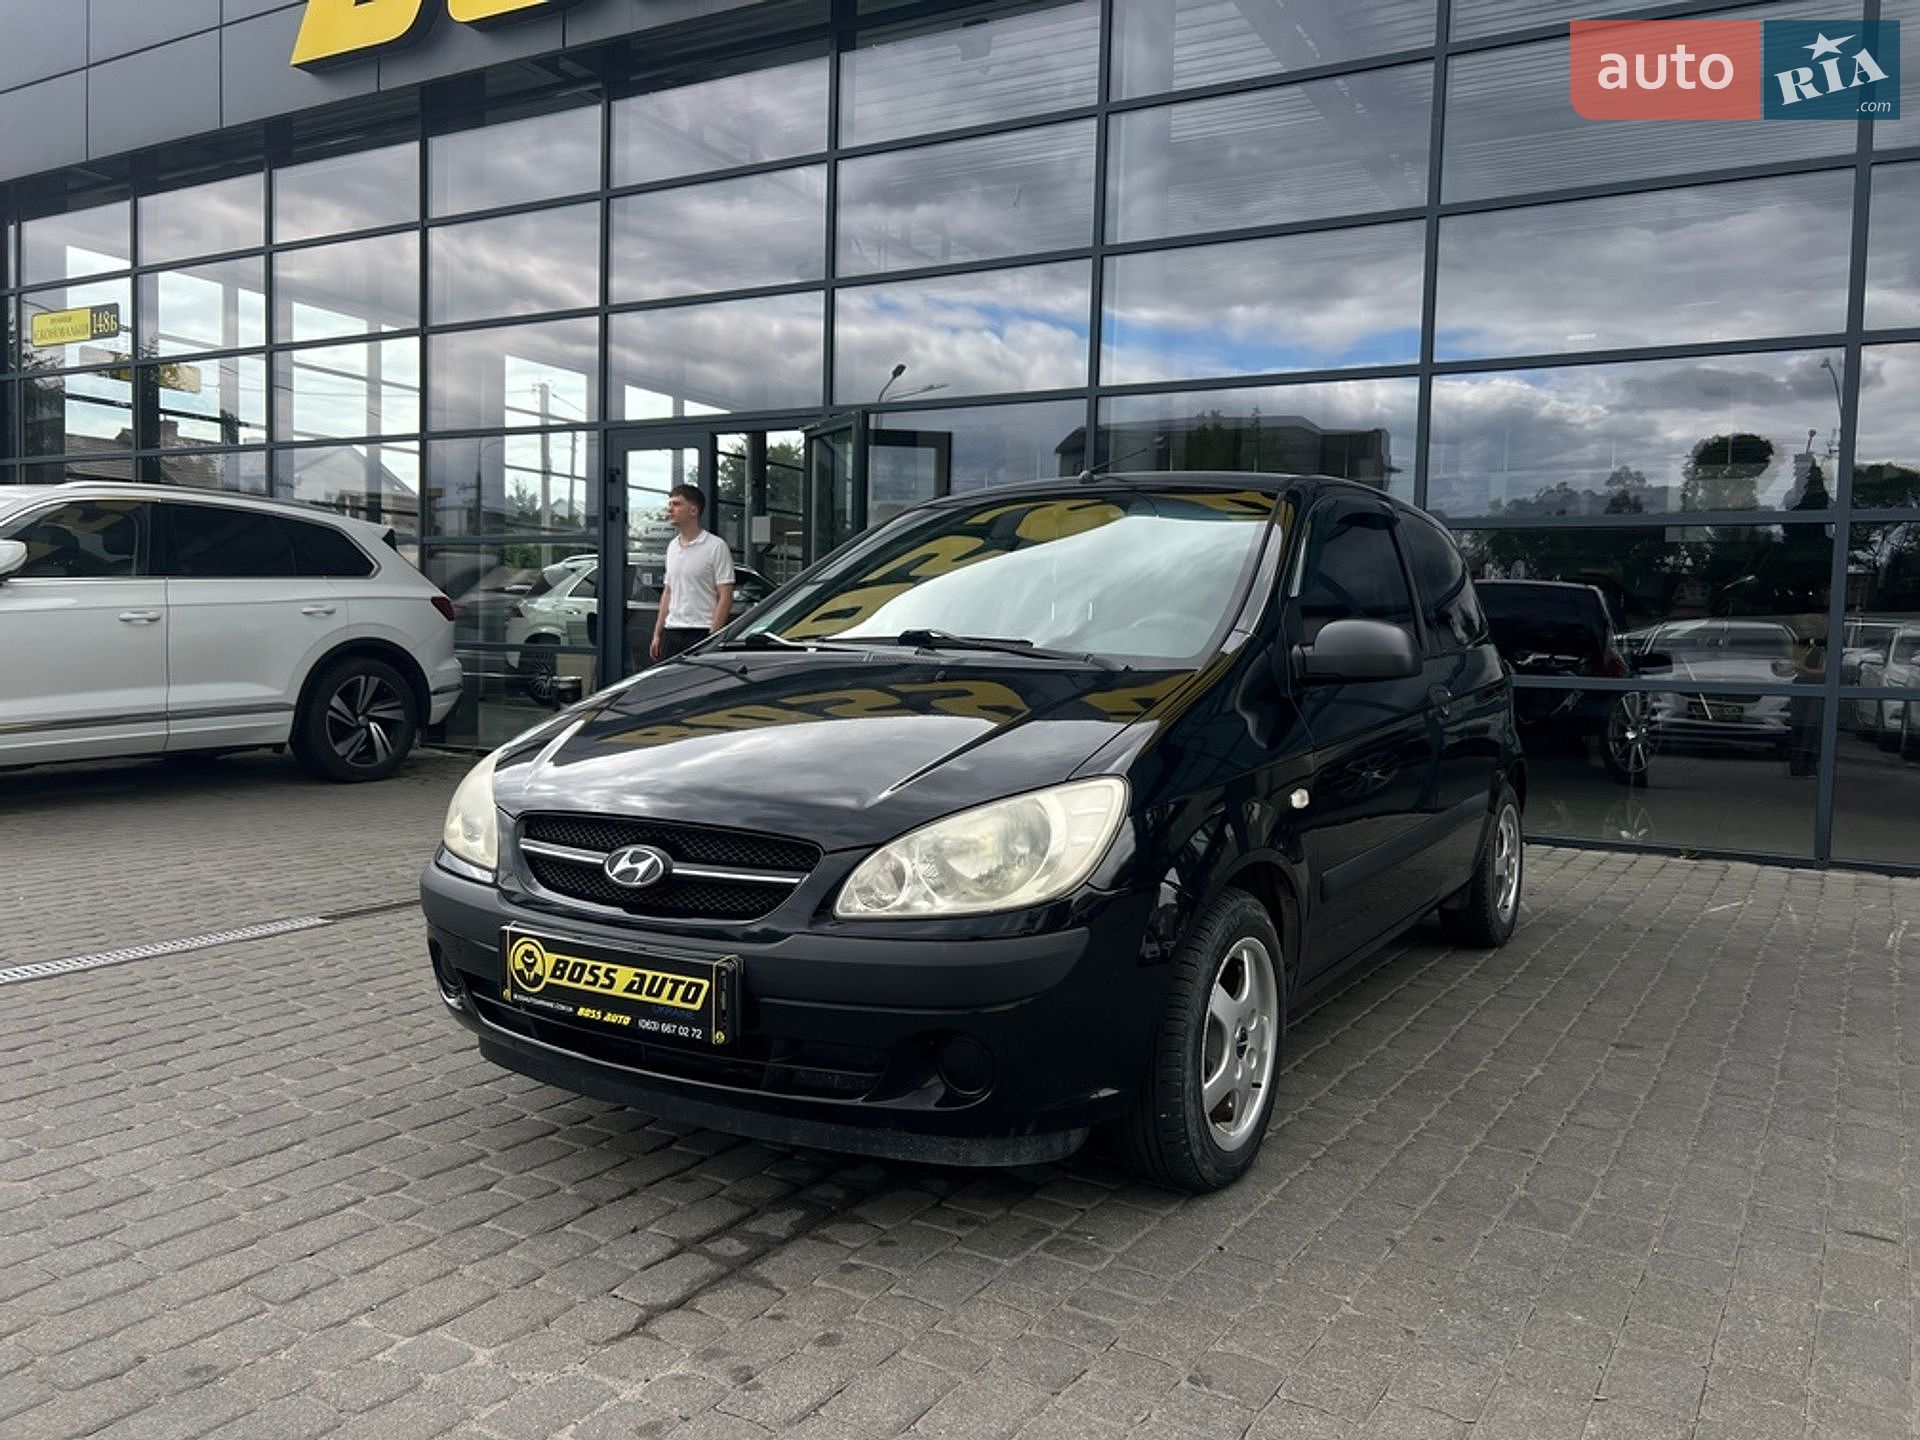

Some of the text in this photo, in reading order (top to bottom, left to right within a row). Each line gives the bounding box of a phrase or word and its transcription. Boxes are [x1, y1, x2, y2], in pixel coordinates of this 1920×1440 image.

[549, 958, 704, 1005] BOSS AUTO
[577, 1006, 632, 1026] BOSS AUTO
[691, 1028, 703, 1040] 72
